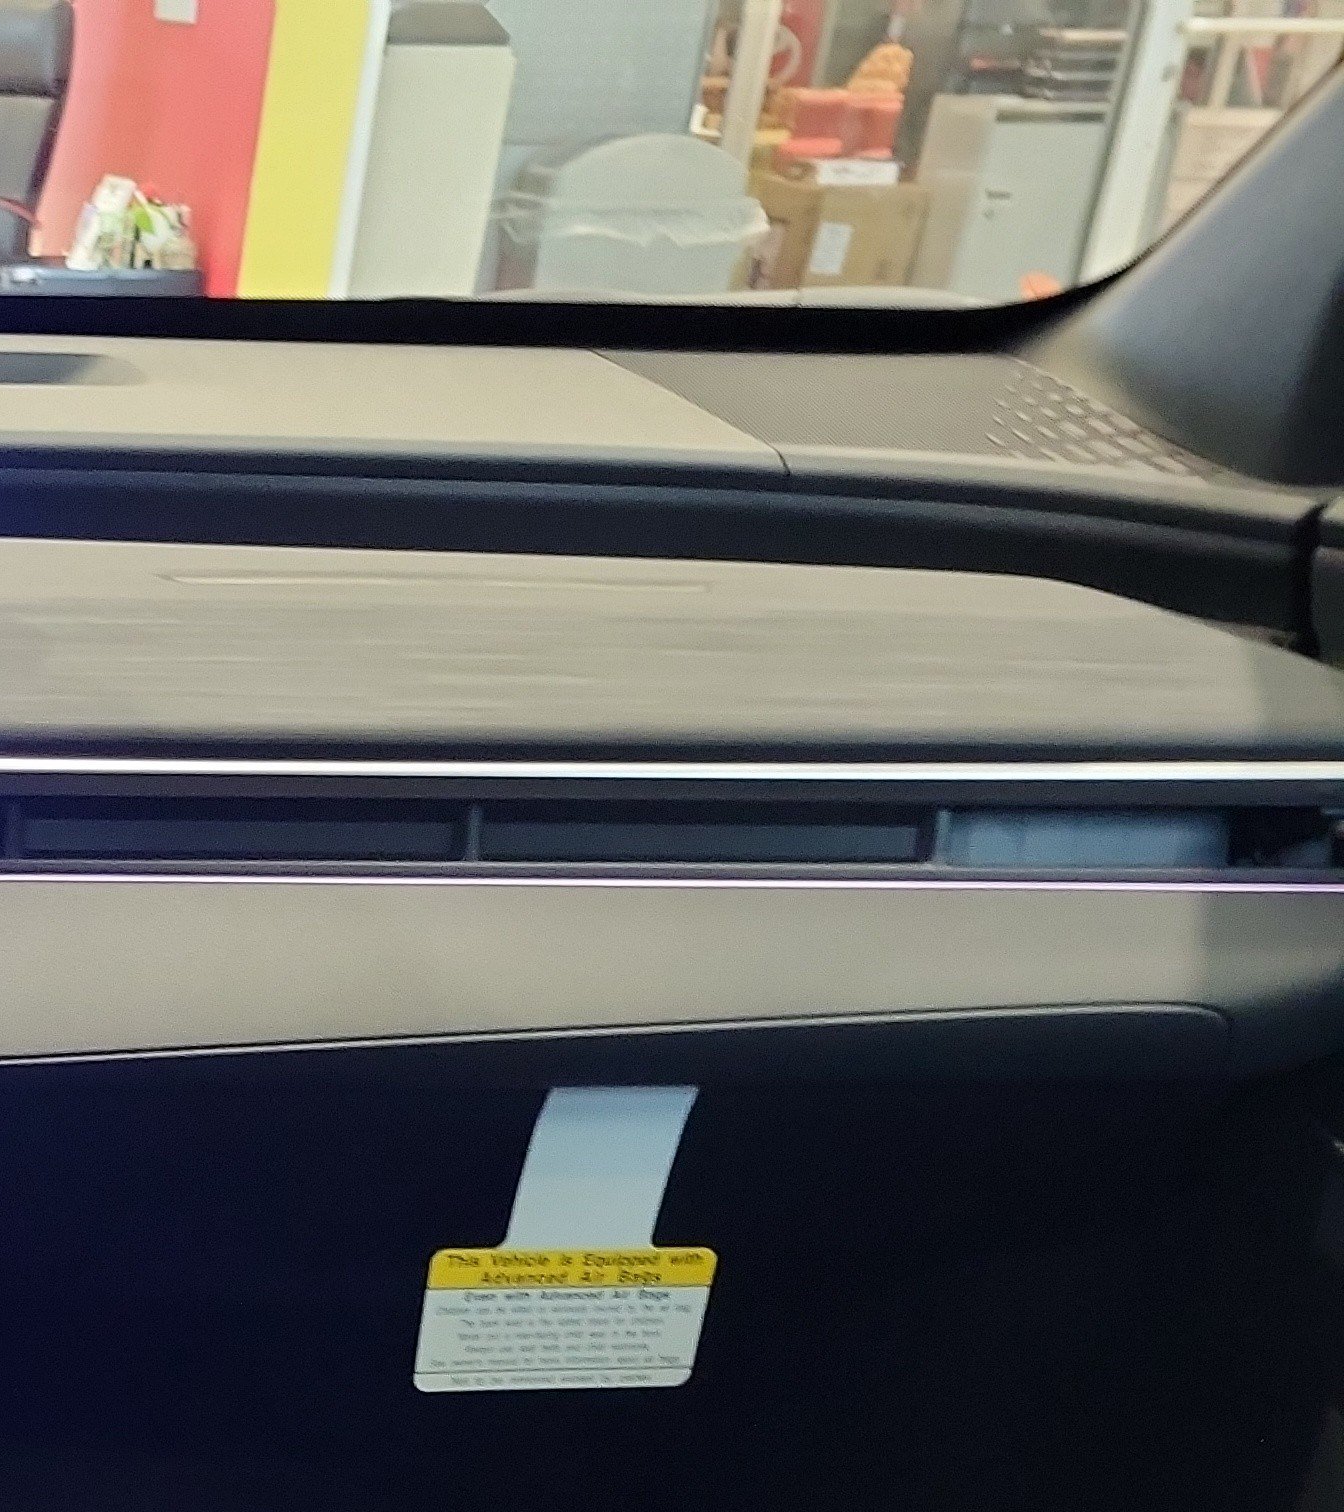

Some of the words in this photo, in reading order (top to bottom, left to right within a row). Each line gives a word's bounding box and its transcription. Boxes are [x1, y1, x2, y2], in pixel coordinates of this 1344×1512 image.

[448, 1254, 479, 1267] This
[491, 1253, 550, 1267] Vehicle
[582, 1253, 661, 1268] Equipped
[480, 1271, 569, 1285] Advanced
[616, 1269, 661, 1286] Bags
